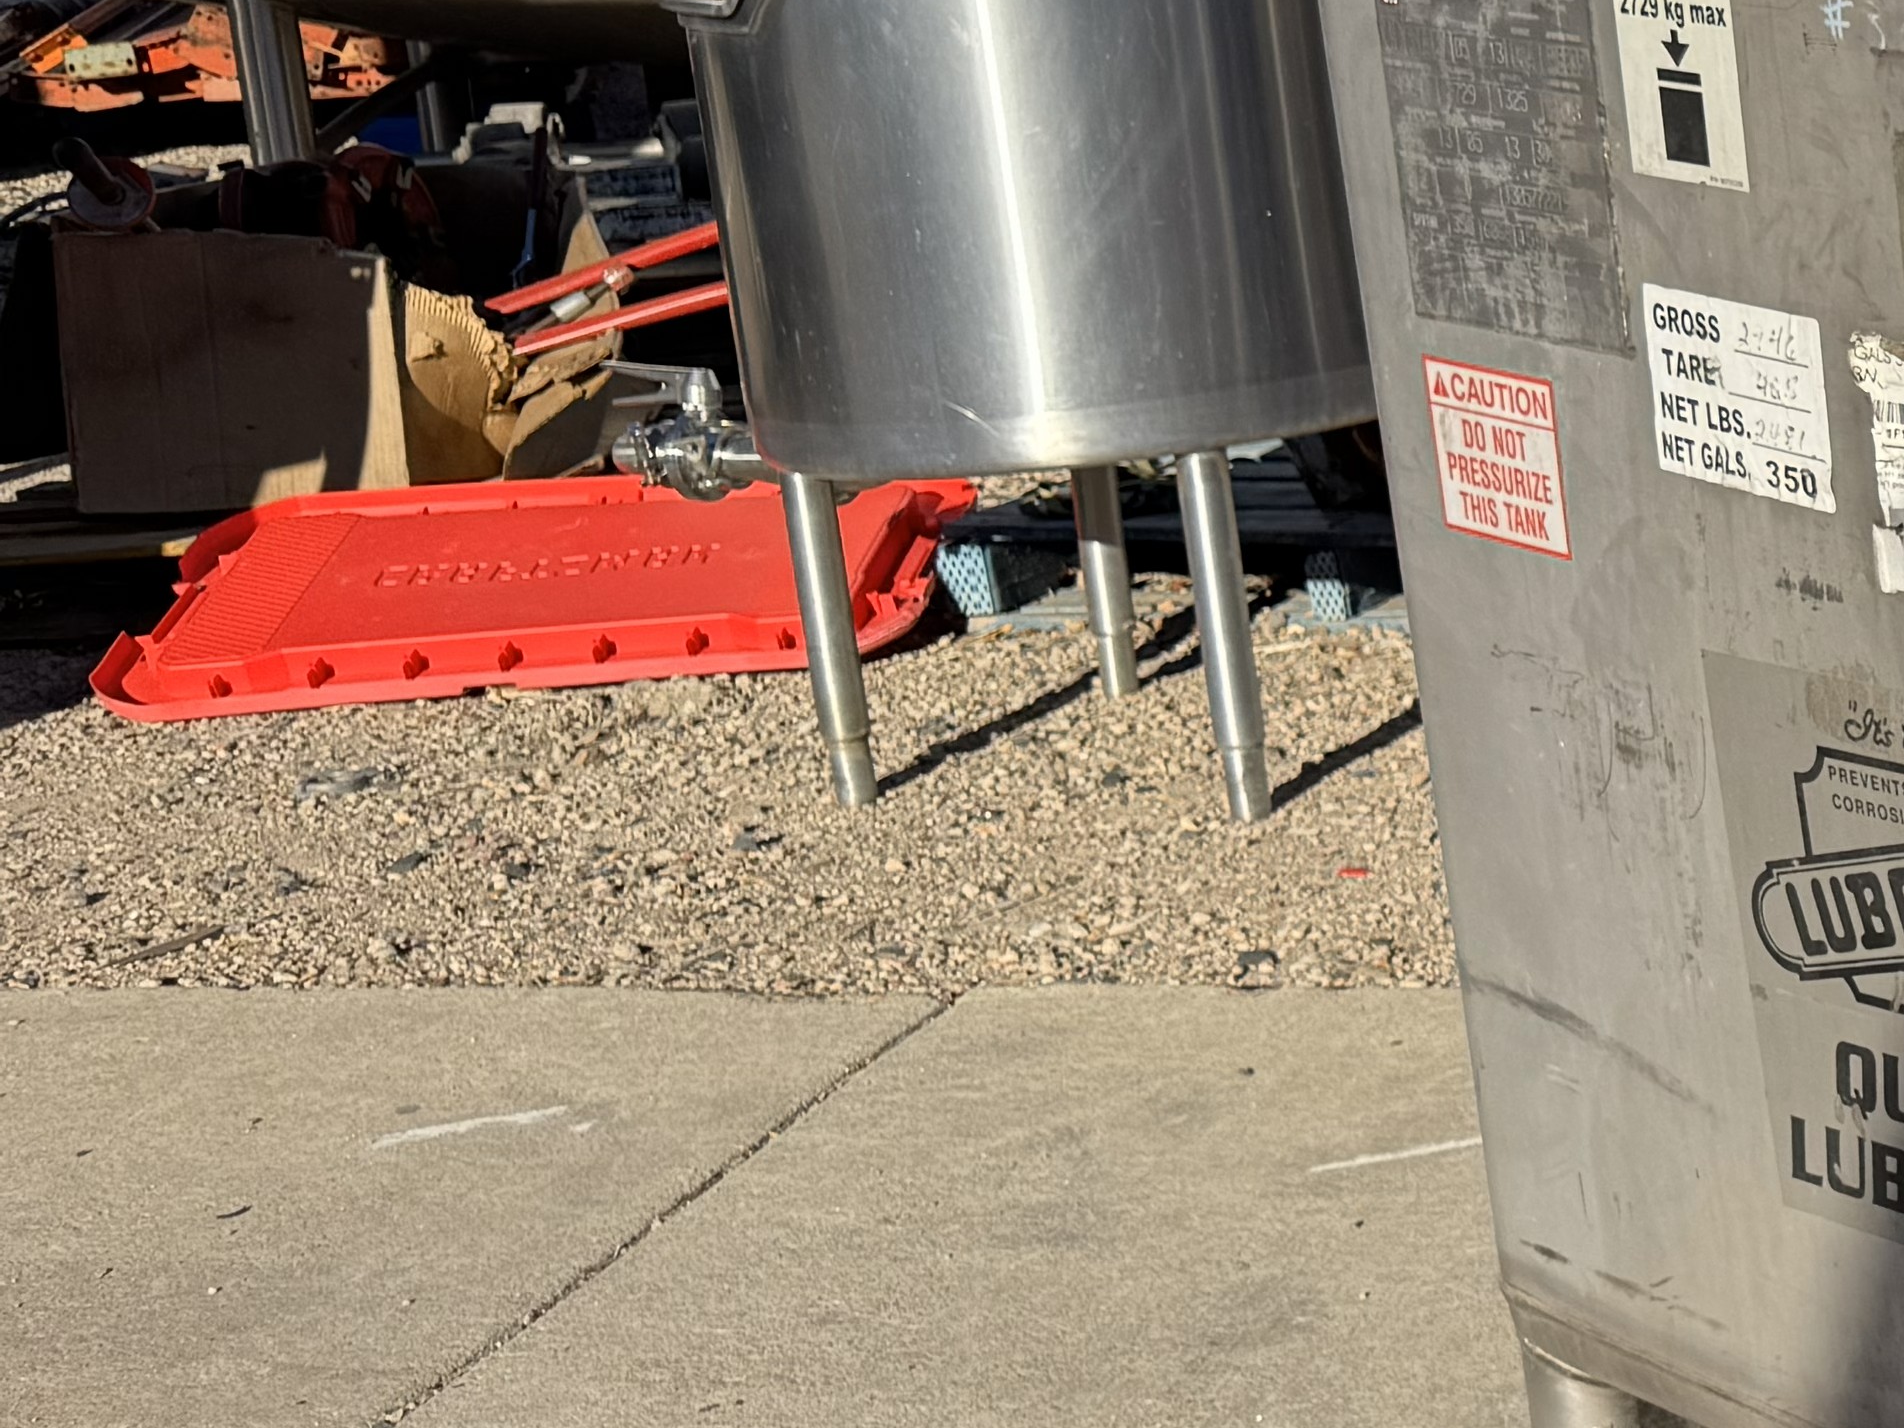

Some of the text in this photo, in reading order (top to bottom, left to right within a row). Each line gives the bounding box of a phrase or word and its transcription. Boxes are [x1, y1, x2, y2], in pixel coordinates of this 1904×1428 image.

[1689, 4, 1728, 28] max
[1652, 302, 1721, 344] GROSS
[1661, 347, 1717, 386] TARE
[1450, 374, 1549, 421] CAUTION
[1660, 391, 1699, 426] NET
[1705, 401, 1751, 439] LBS.
[1461, 418, 1526, 462] DO NOT
[1446, 451, 1554, 505] PRESSURIZE
[1661, 430, 1818, 498] NET GALS. 350
[1459, 490, 1551, 542] THIS TANK
